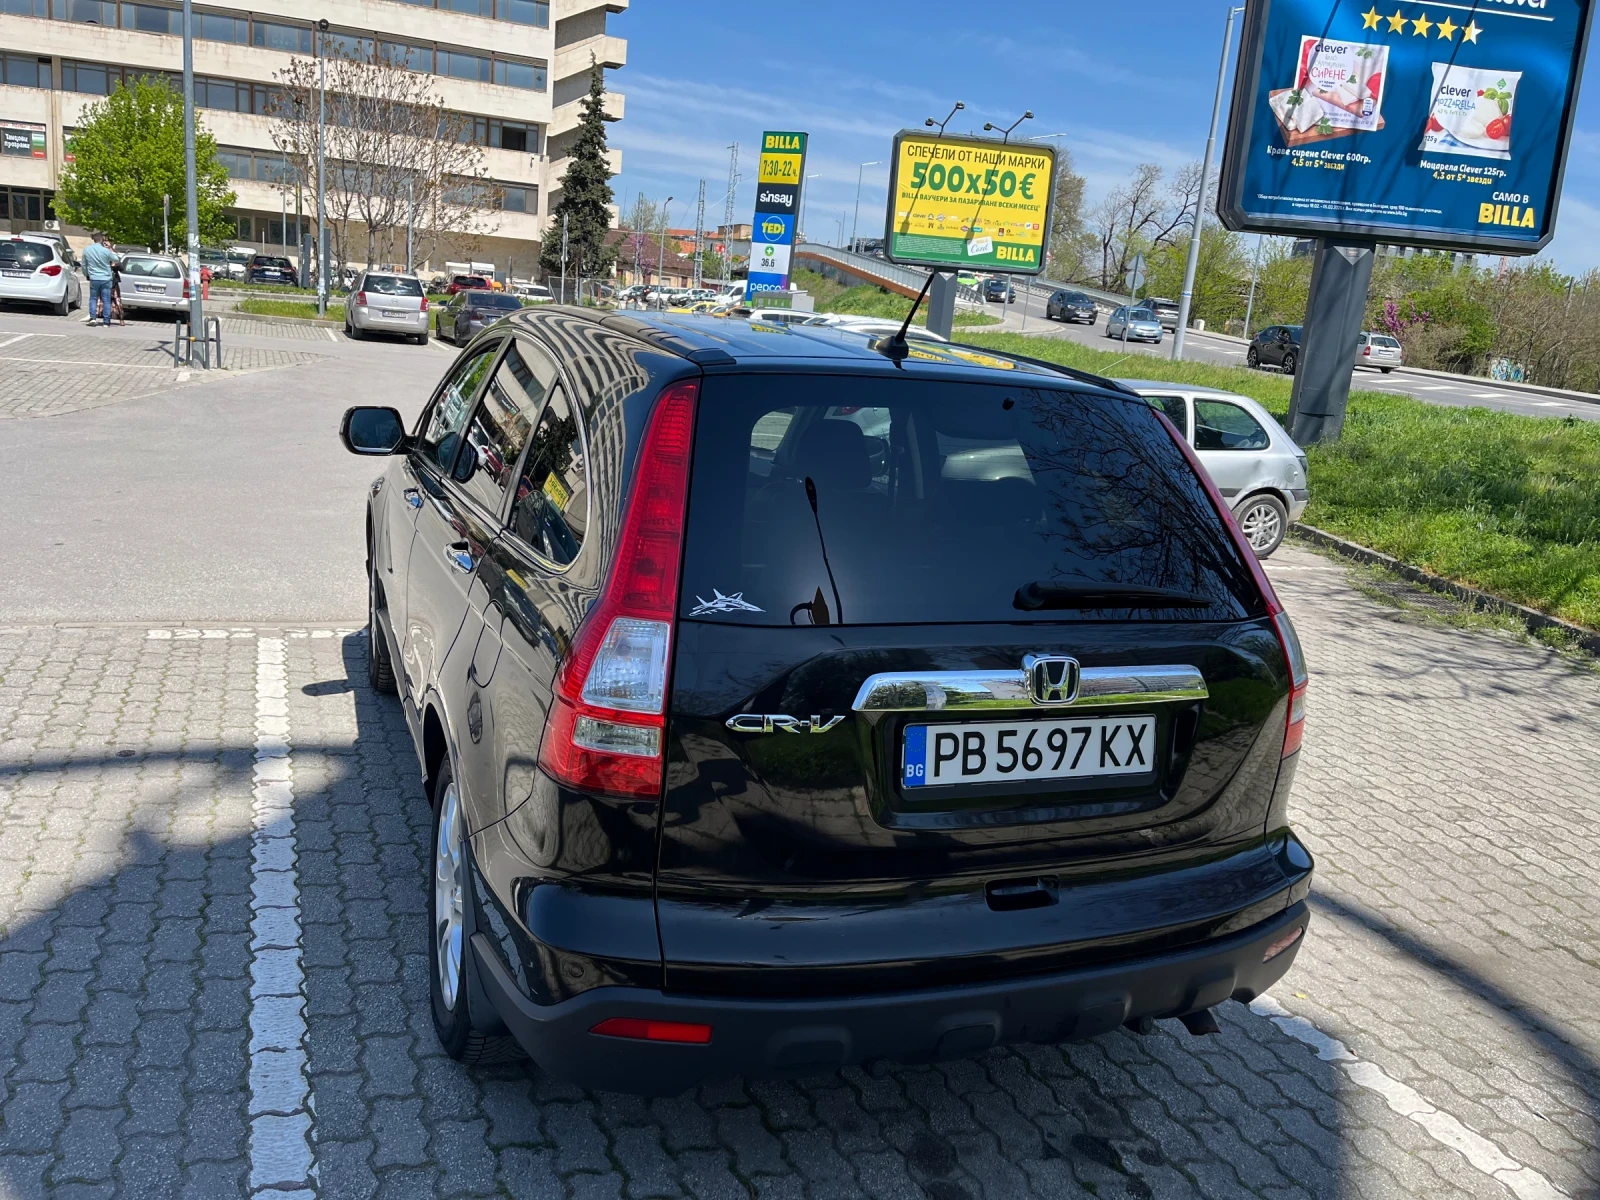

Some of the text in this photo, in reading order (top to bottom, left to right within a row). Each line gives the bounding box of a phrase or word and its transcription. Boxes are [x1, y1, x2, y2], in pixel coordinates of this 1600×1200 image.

[1315, 43, 1348, 54] clever
[1440, 85, 1471, 97] clever
[765, 136, 800, 149] BILLA
[907, 144, 1045, 170] СПЕЧЕЛИ ОТ НАШИ МАРКИ
[1266, 145, 1372, 164] Краве сирене Clever 600гр.
[1324, 162, 1345, 170] звезди
[1420, 160, 1507, 178] Моцарела Clever 125гр.
[1466, 176, 1492, 185] звезди
[760, 190, 793, 207] sinsay
[920, 193, 948, 202] ВАУЧЕРИ
[1492, 191, 1530, 203] САМО В
[1478, 202, 1536, 228] BILLA
[762, 222, 786, 235] TEDi
[996, 246, 1035, 262] BILLA
[750, 282, 782, 292] pepco
[725, 714, 846, 734] CR-V
[905, 763, 924, 778] BG
